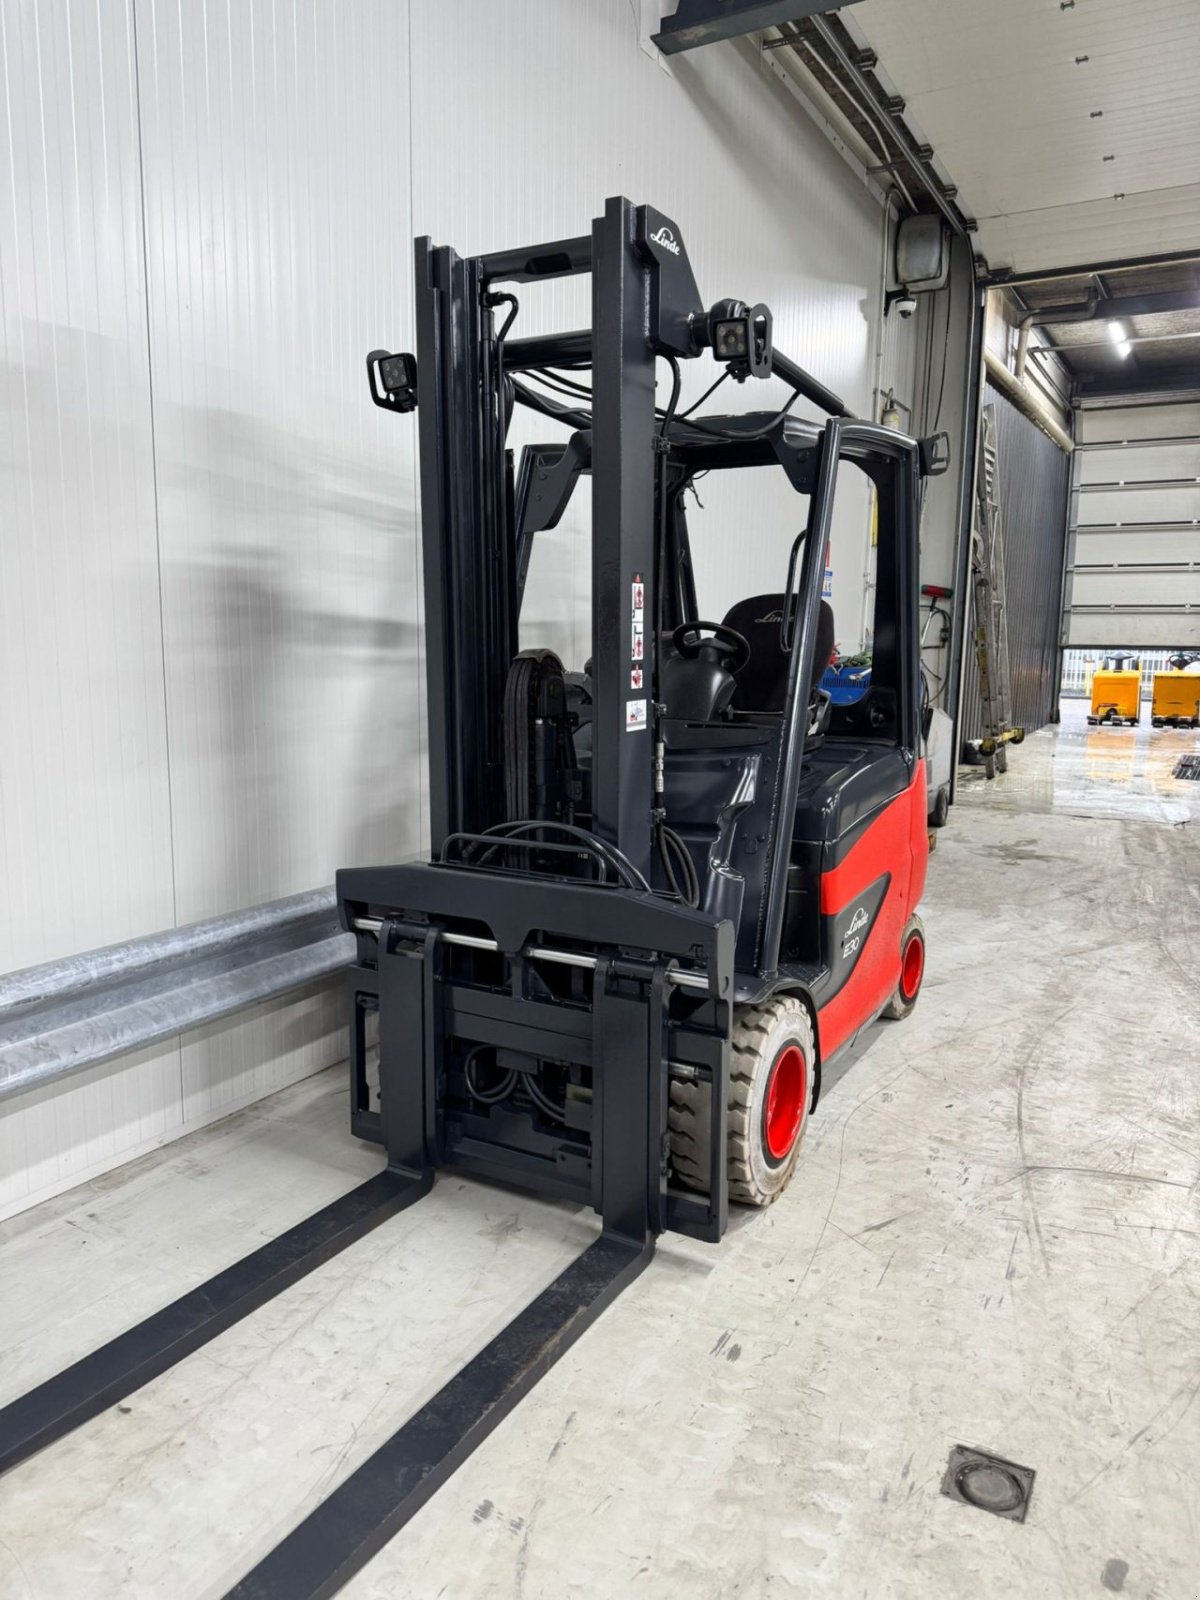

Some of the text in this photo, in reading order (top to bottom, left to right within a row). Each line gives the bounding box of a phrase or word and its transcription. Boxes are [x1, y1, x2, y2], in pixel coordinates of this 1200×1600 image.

[650, 227, 680, 256] Linde
[754, 609, 794, 623] Lin
[844, 907, 869, 938] Linde
[843, 936, 860, 959] E30
